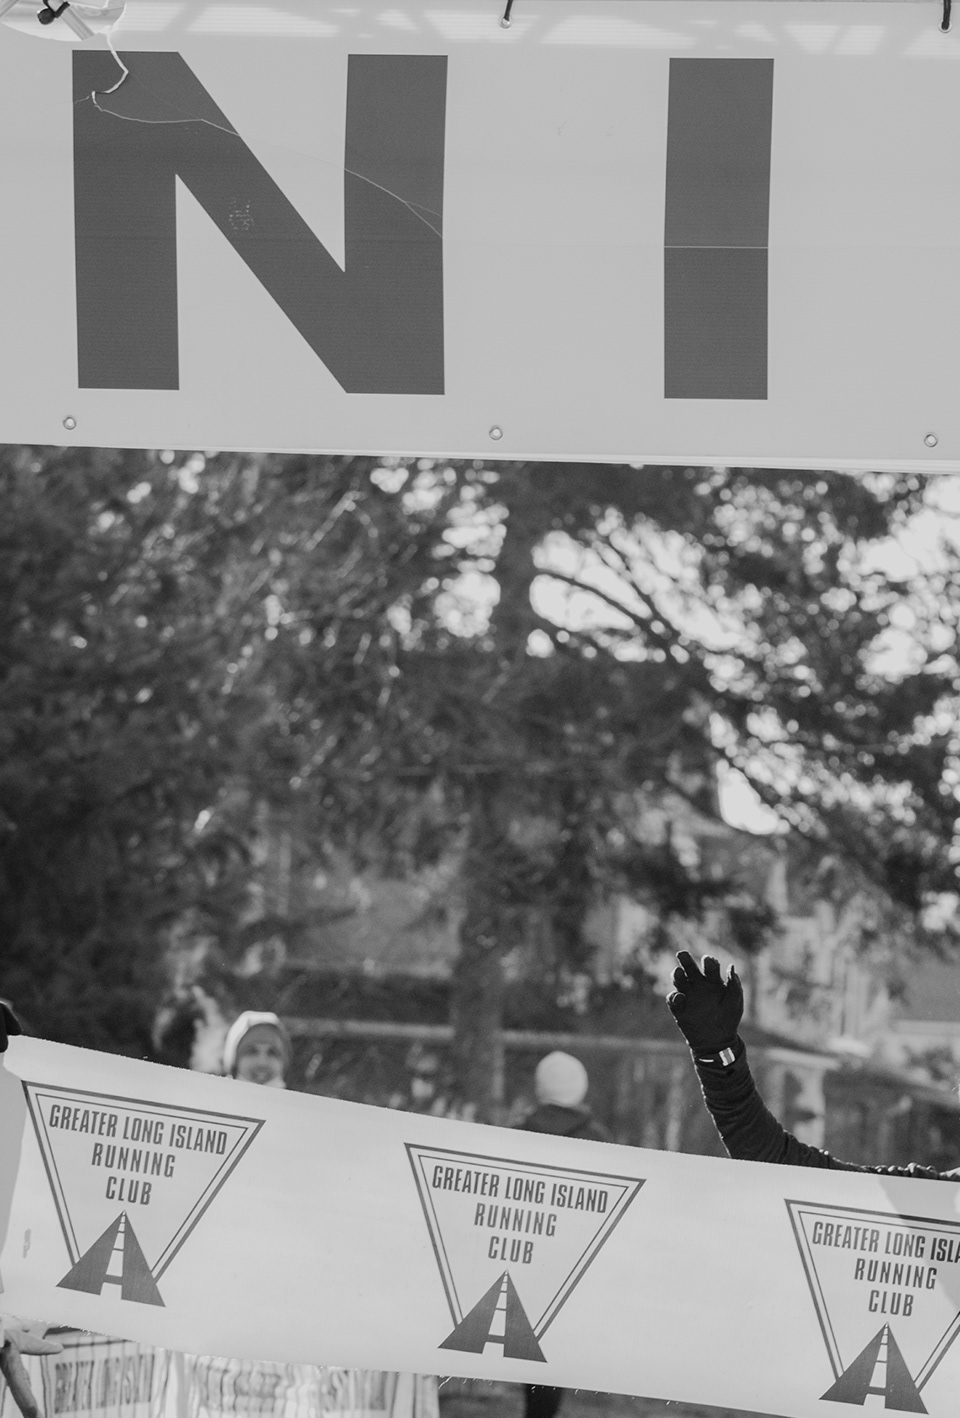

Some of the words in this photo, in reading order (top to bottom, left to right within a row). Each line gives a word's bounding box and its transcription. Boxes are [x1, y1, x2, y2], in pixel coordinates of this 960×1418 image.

[48, 1104, 119, 1138] GREATER
[122, 1116, 165, 1145] LONG
[168, 1123, 228, 1156] ISLAND
[91, 1142, 176, 1178] RUNNING
[105, 1175, 153, 1206] CLUB
[431, 1165, 500, 1198] GREATER
[504, 1176, 546, 1204] LONG
[550, 1183, 609, 1214] ISLAND
[473, 1202, 557, 1237] RUNNING
[487, 1235, 534, 1265] CLUB
[811, 1221, 880, 1253] GREATER
[884, 1231, 927, 1259] LONG
[854, 1257, 938, 1290] RUNNING
[868, 1289, 914, 1316] CLUB
